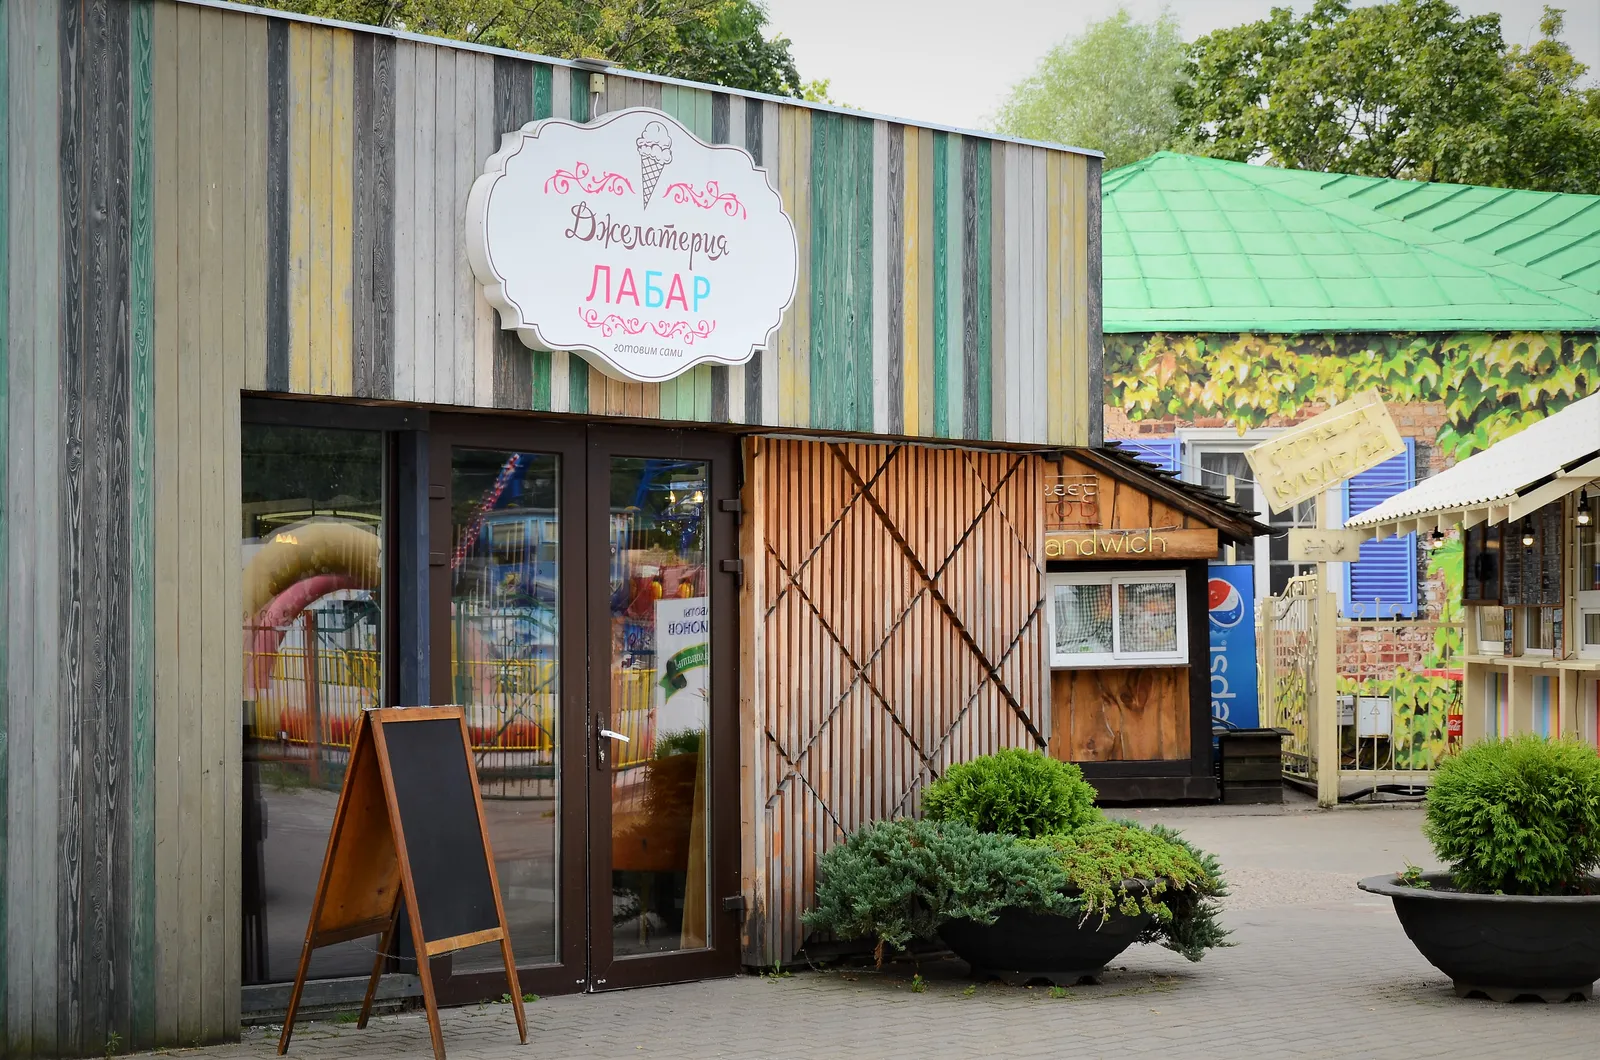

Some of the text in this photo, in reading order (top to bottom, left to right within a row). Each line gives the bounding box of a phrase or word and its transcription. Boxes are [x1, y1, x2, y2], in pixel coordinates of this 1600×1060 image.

[565, 201, 730, 271] Джелатерия
[585, 264, 711, 312] ЛАБАР
[613, 343, 684, 358] готовим сами
[1210, 647, 1236, 729] epsi
